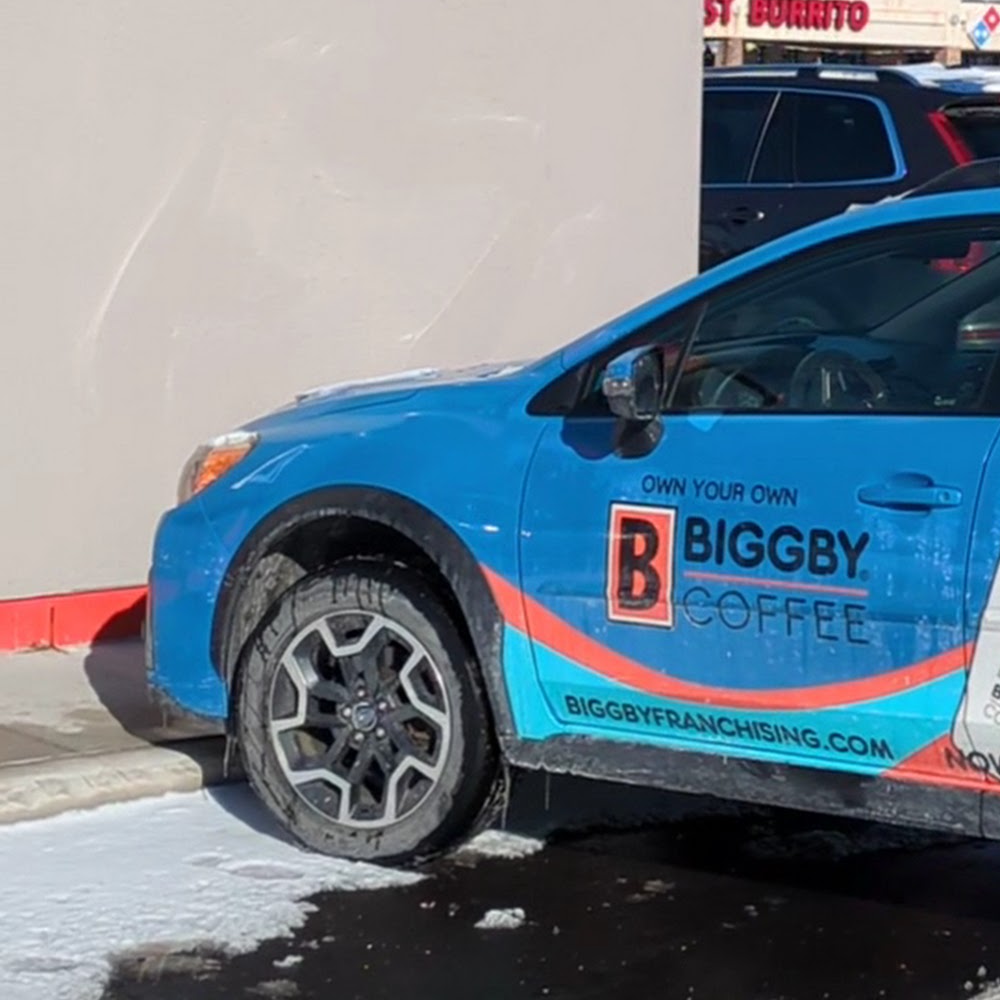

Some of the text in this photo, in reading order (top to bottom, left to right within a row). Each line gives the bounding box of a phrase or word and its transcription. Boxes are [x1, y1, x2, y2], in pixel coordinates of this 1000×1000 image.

[641, 474, 798, 507] OWN YOUR OWN
[617, 516, 661, 611] B
[683, 516, 870, 579] BIGGBY
[682, 586, 870, 645] COFFEE
[564, 695, 895, 760] BIGGBYFRANCHISING.COM
